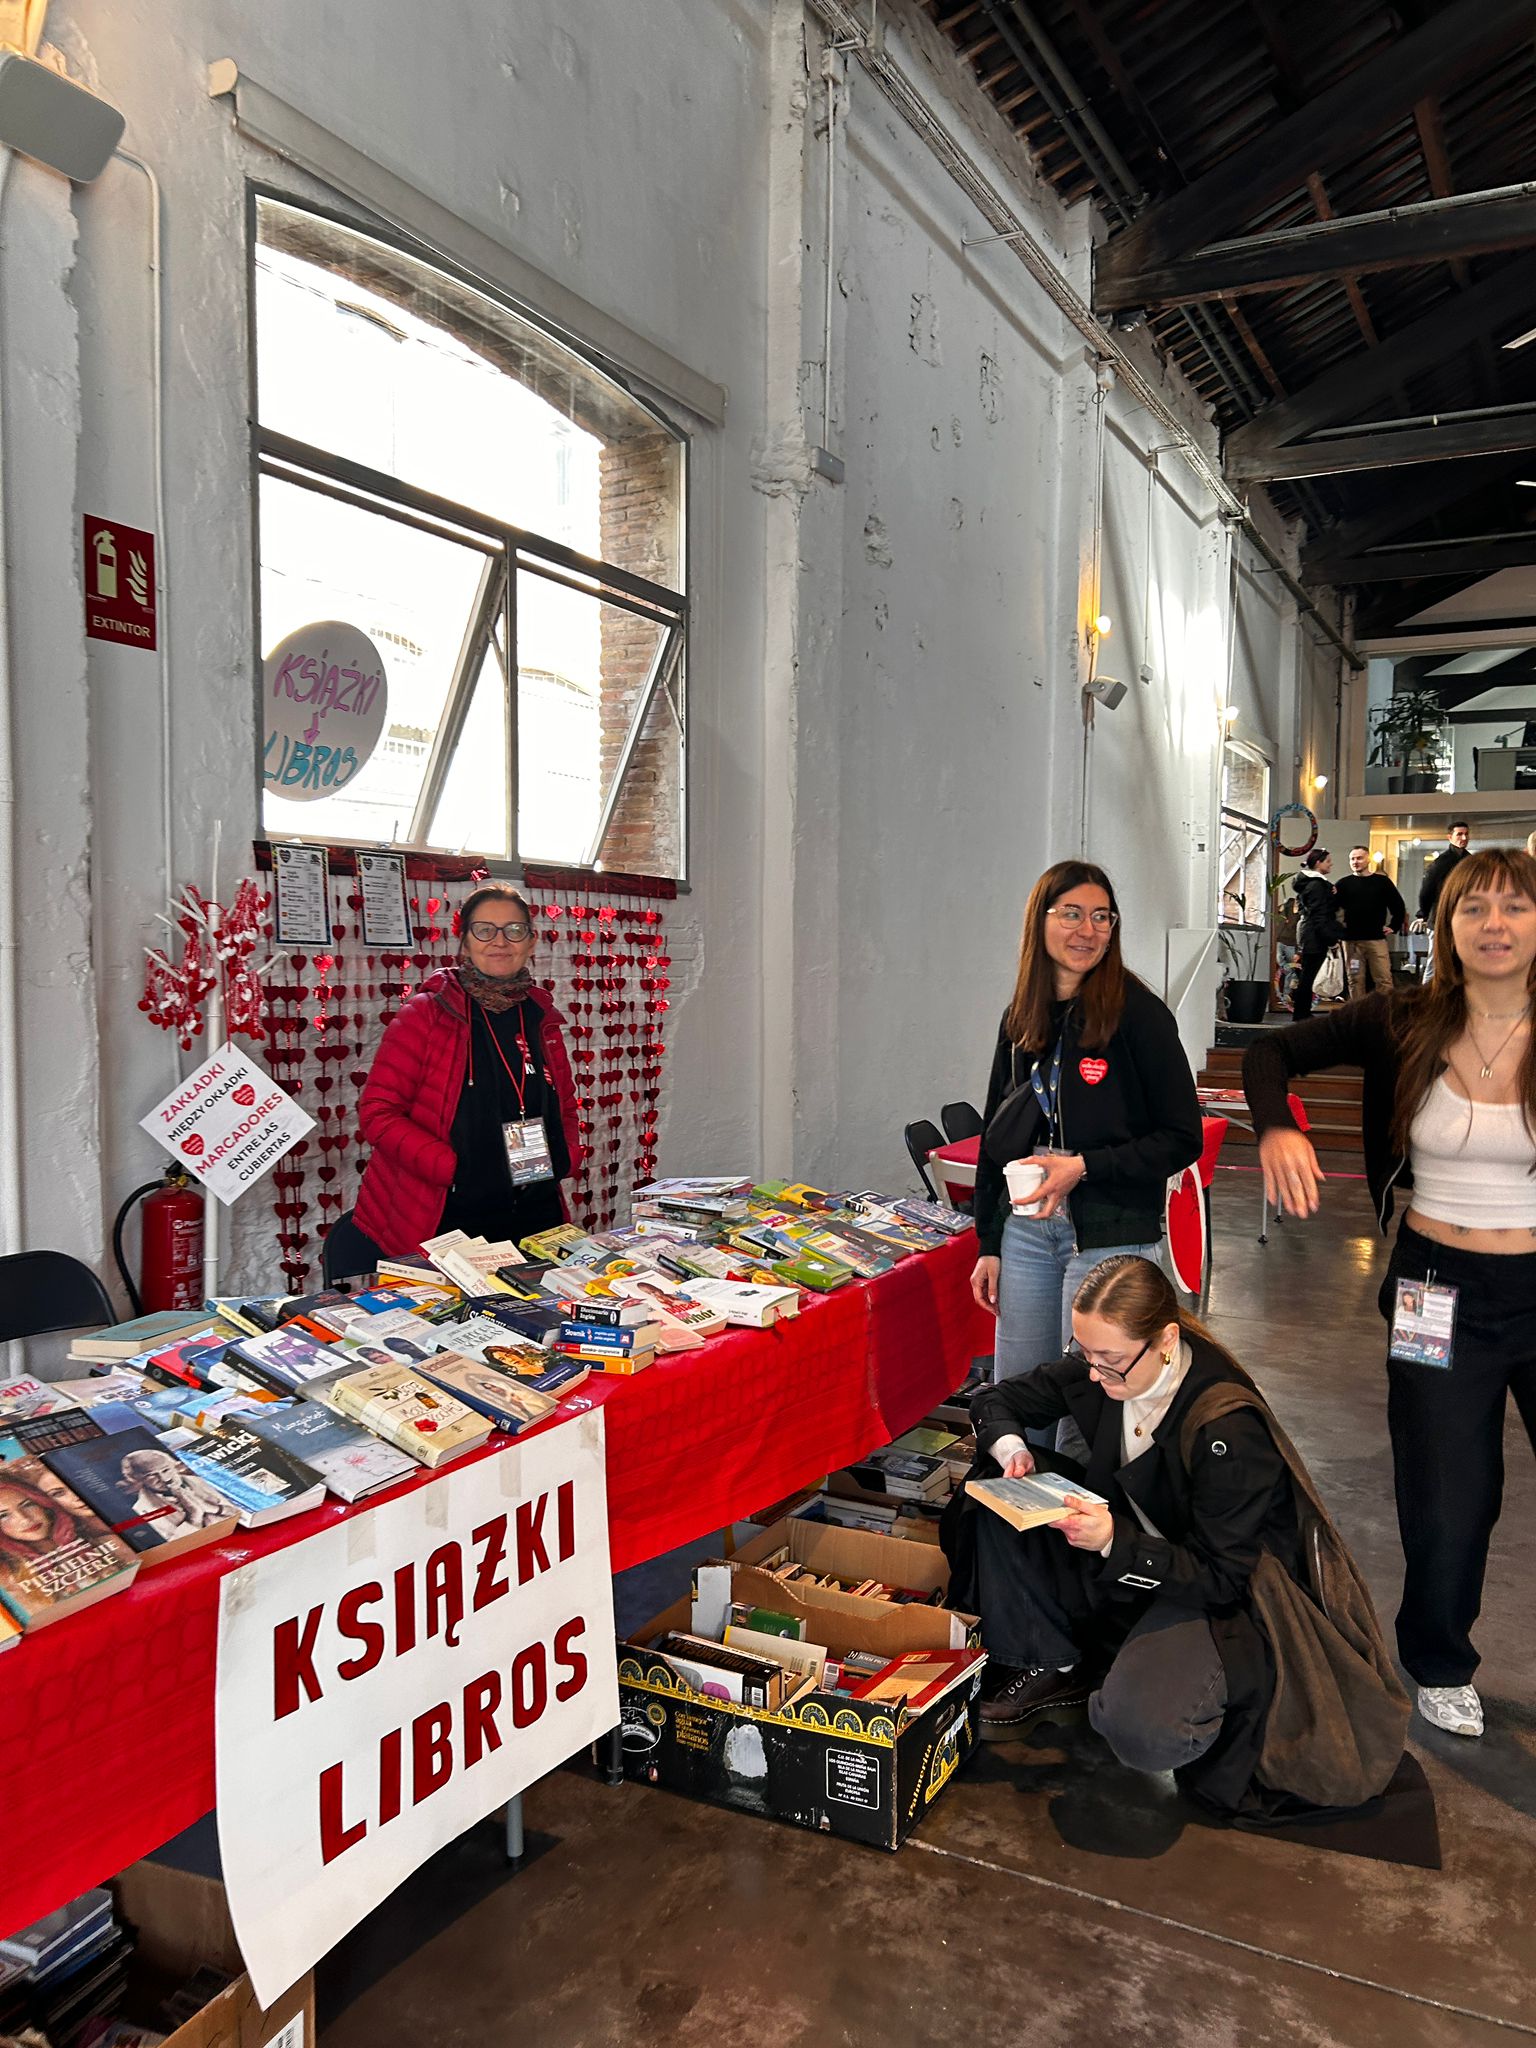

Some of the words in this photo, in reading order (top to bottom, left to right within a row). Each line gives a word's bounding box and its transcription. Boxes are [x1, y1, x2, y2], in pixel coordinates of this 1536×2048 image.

[92, 615, 151, 638] EXTINTOR
[160, 1062, 226, 1123] ZAKŁADKI
[168, 1105, 206, 1142] MIĘDZY
[204, 1067, 249, 1108] OKŁADKI
[195, 1092, 283, 1175] MARCADORES
[227, 1138, 261, 1170] ENTRE
[260, 1122, 279, 1141] LAS
[239, 1132, 291, 1181] CUBIERTAS
[18, 1540, 119, 1593] PIEKIELNIE
[41, 1554, 118, 1597] SZCZERE
[274, 1480, 574, 1721] KSIĄŻKI
[319, 1616, 588, 1866] LIBROS
[908, 1744, 932, 1818] Palmerita
